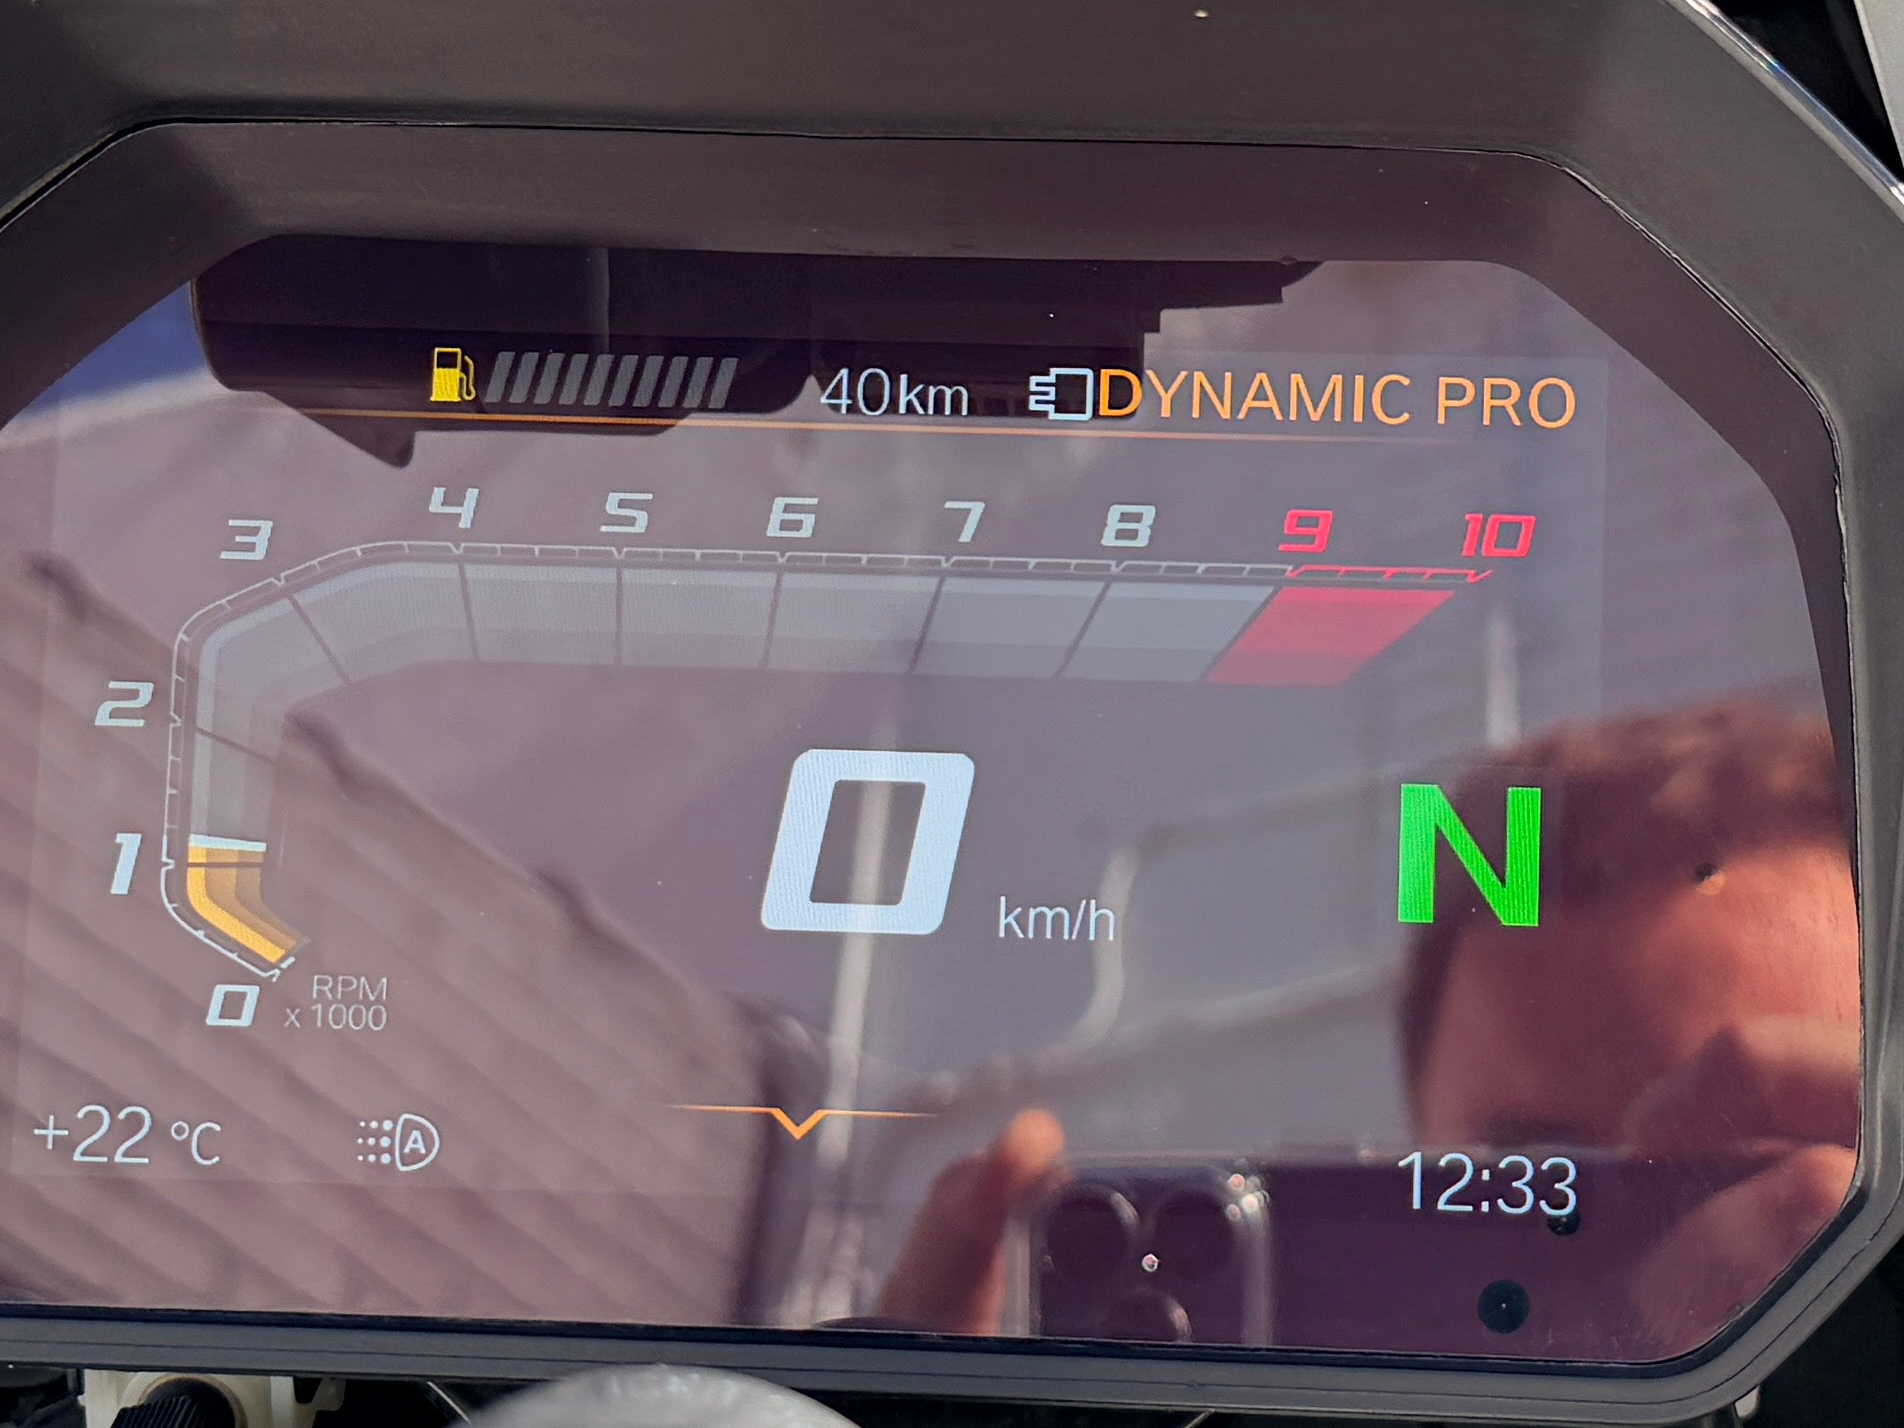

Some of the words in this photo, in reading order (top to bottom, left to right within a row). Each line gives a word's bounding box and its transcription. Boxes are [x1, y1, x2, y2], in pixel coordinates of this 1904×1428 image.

[1098, 368, 1411, 425] DYNAMIC
[1436, 376, 1576, 429] PRO
[428, 486, 479, 528] 4
[600, 492, 653, 533] 5
[766, 497, 819, 538] 6
[942, 500, 986, 543] 7
[1100, 504, 1156, 547] 8
[220, 518, 273, 560] 3
[1278, 509, 1333, 553] 9
[1460, 512, 1537, 557] 10
[95, 681, 154, 726] 2
[109, 832, 141, 895] 1
[760, 747, 975, 936] 0
[1398, 782, 1542, 927] N
[998, 897, 1117, 942] km/h
[205, 984, 261, 1027] 0
[312, 974, 389, 1002] RPM
[33, 1105, 151, 1165] +22
[1396, 1149, 1579, 1216] 12:33
